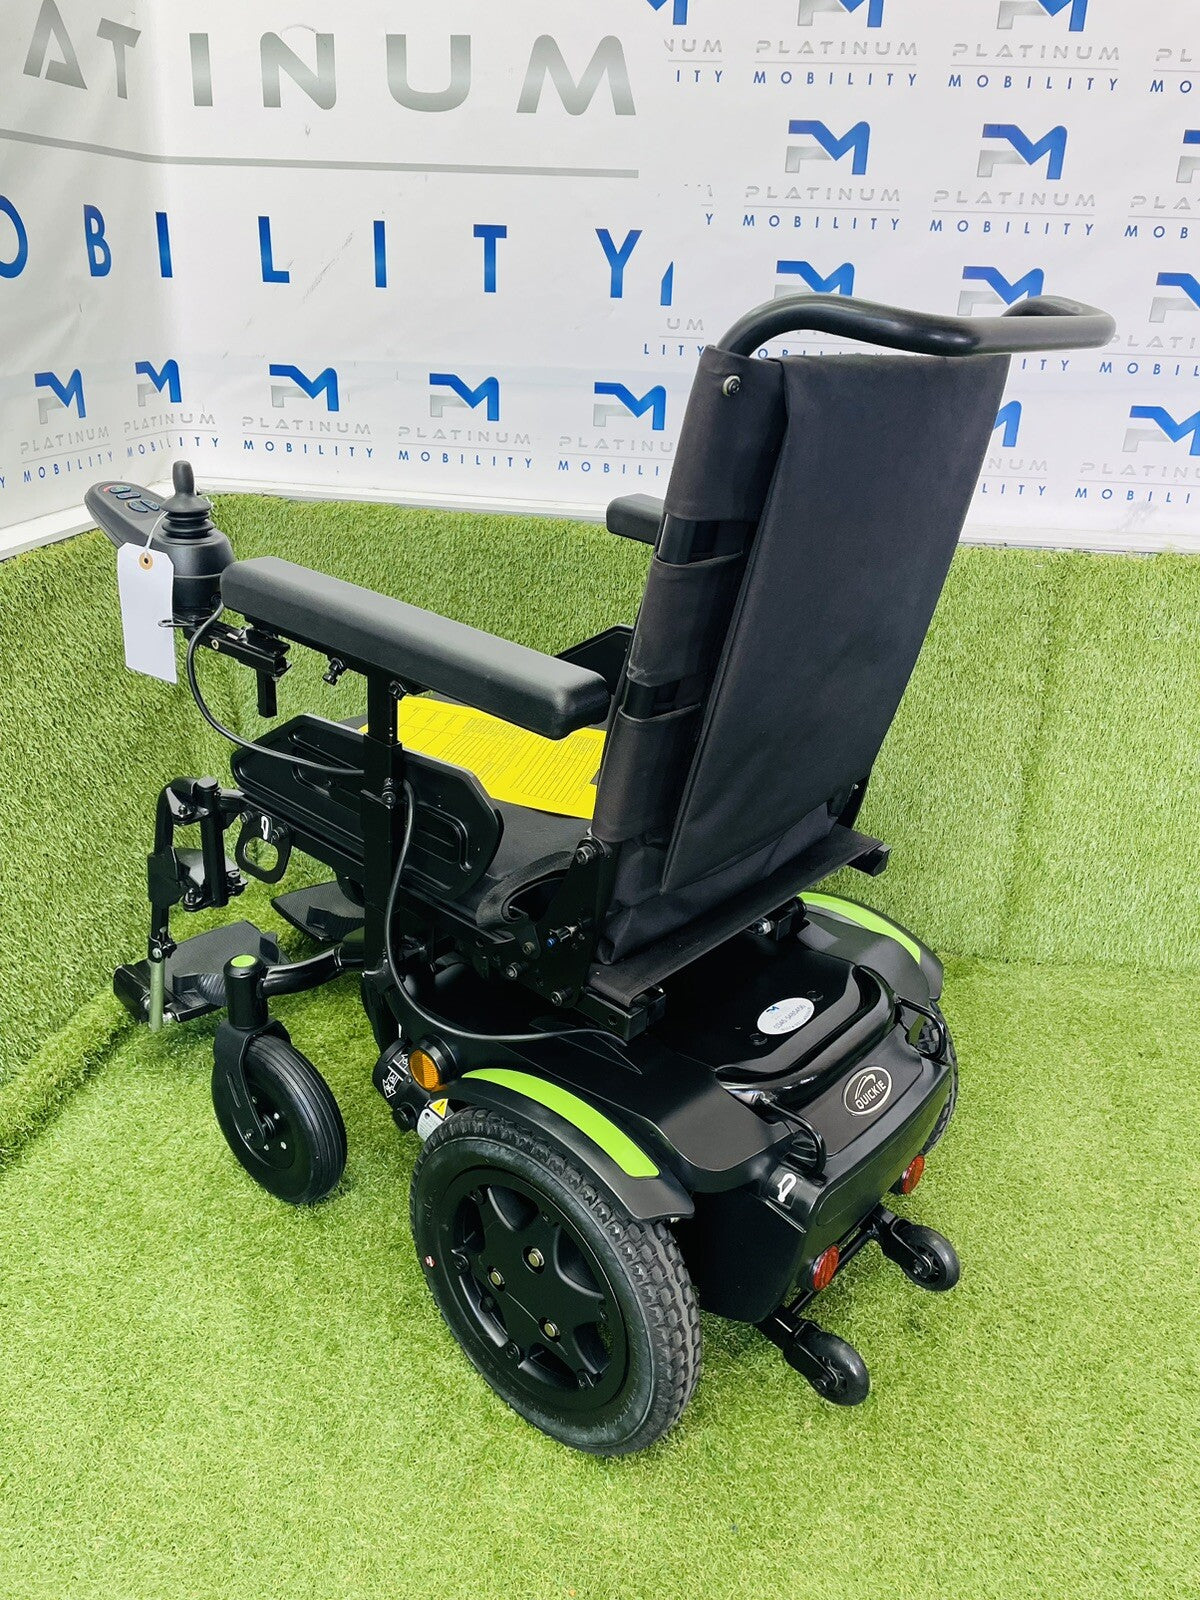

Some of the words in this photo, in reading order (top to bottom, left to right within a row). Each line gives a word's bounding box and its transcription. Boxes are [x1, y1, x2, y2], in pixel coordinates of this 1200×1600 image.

[756, 40, 917, 56] PLATINUM
[952, 43, 1119, 61] PLATINUM
[1156, 48, 1192, 63] PL
[23, 0, 636, 116] ATINUM
[677, 70, 723, 83] ITY
[753, 71, 917, 86] MOBILITY
[948, 74, 1120, 92] MOBILITY
[1149, 79, 1192, 95] MO
[745, 186, 900, 201] PLATINUM
[934, 190, 1095, 207] PLATINUM
[743, 214, 900, 230] MOBILITY
[929, 219, 1094, 235] MOBILITY
[1124, 224, 1188, 240] MOB
[0, 195, 643, 299] OBILITY
[644, 344, 704, 356] LITY
[1022, 357, 1069, 371] ITY
[1099, 360, 1200, 377] MOBIL
[124, 412, 215, 434] PLATINUM
[241, 416, 371, 435] PLATINUM
[20, 426, 109, 455] PLATINUM
[398, 426, 530, 445] PLATINUM
[127, 437, 219, 457] MOBILITY
[242, 440, 373, 458] MOBILITY
[23, 451, 113, 482] MOBILITY
[398, 450, 533, 468] MOBILITY
[558, 460, 659, 476] MOBILI
[982, 483, 1047, 496] LITY
[1075, 487, 1190, 504] MOBILI
[855, 1079, 887, 1110] QUICKIE
